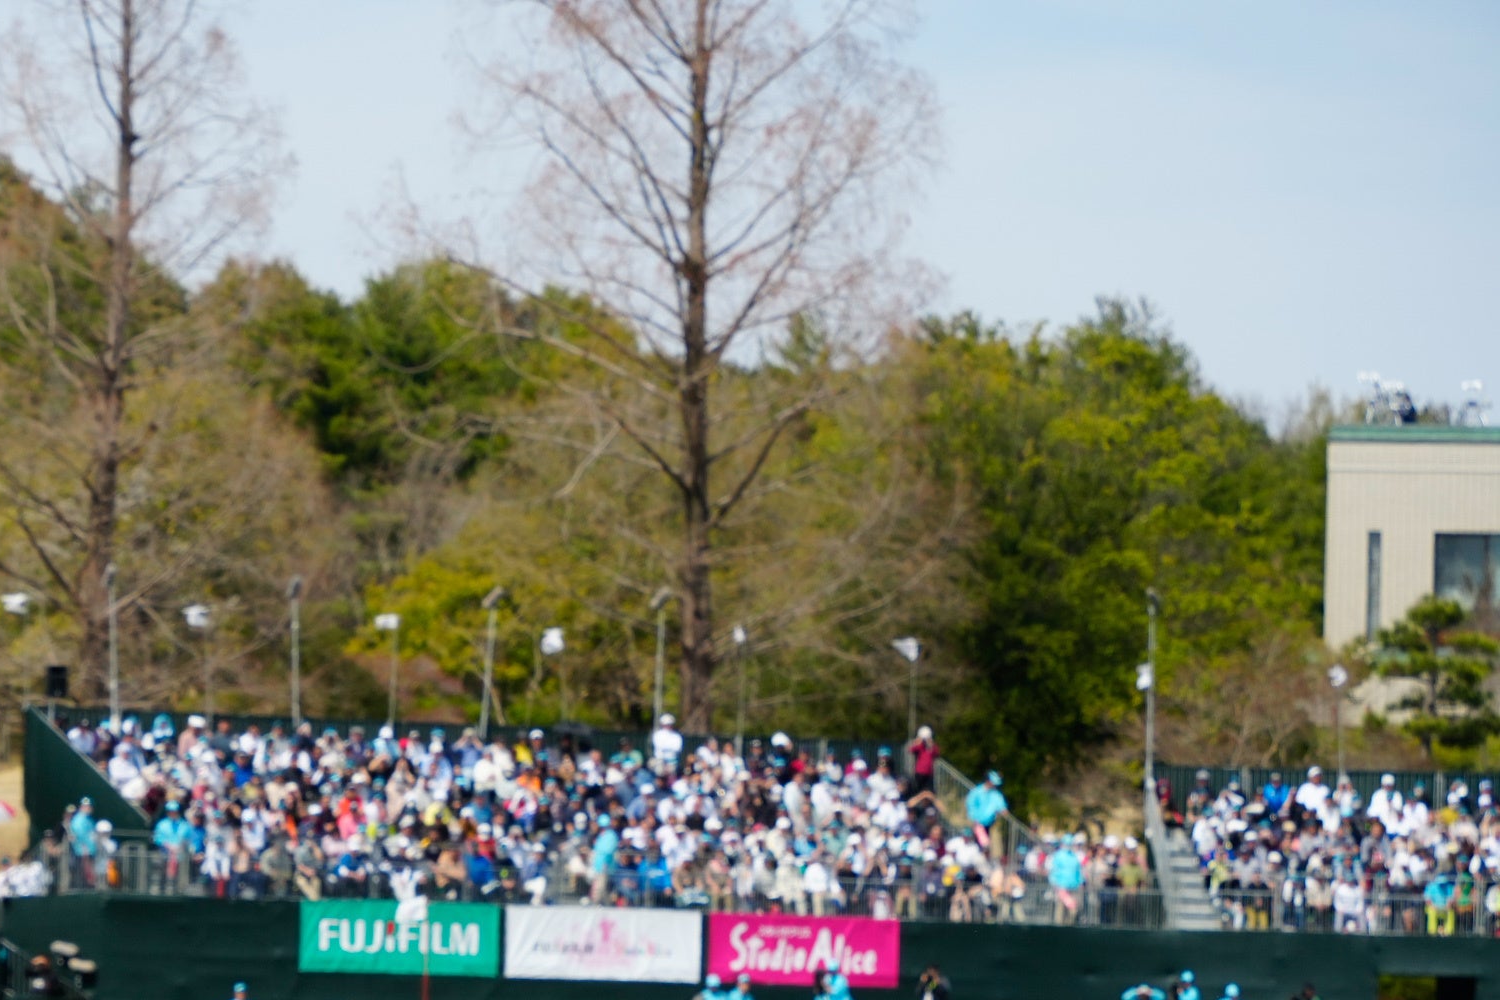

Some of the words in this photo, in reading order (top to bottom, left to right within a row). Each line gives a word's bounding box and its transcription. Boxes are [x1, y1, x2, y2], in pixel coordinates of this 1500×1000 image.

[318, 917, 480, 956] FUJIFILM
[729, 921, 807, 975] Studio
[806, 927, 878, 976] Alice
